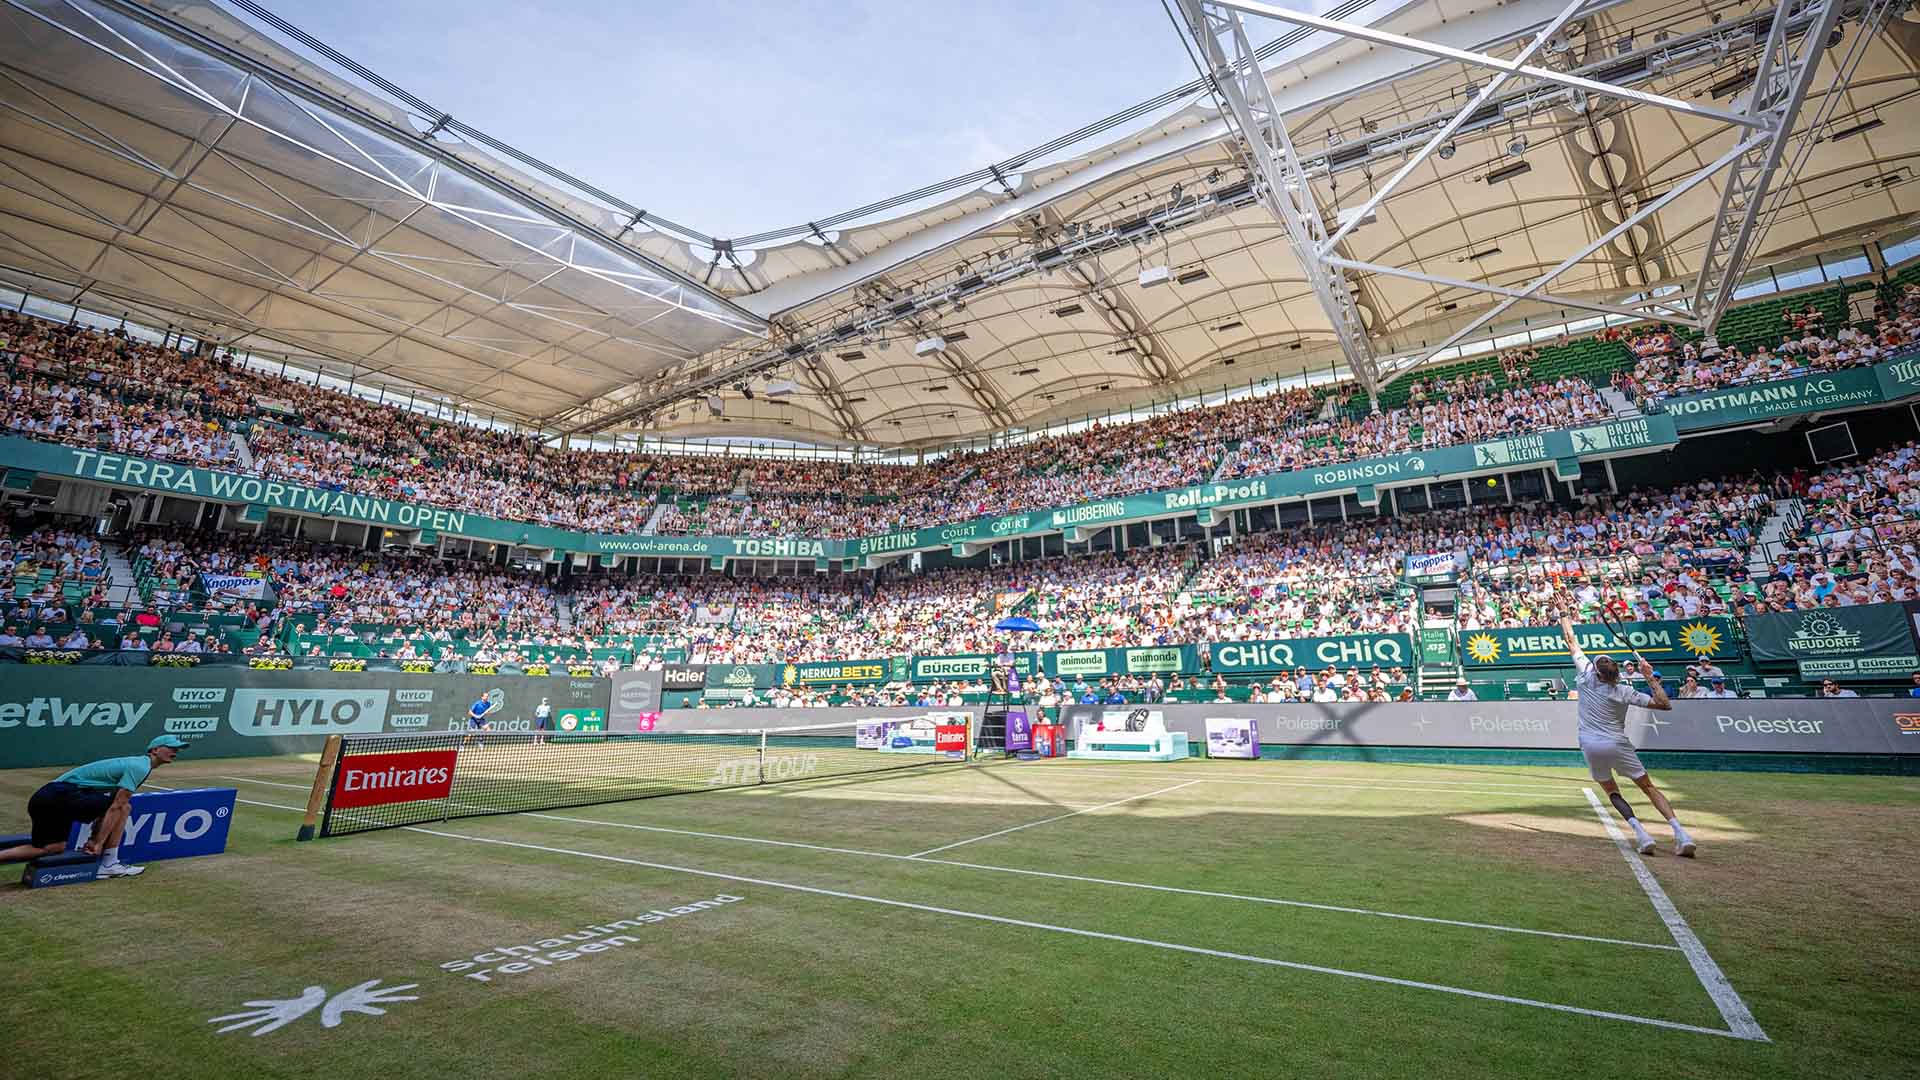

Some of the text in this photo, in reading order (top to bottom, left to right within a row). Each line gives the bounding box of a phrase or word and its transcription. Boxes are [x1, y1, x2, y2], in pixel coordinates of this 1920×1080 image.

[1664, 379, 1836, 416] WORTMANN AG
[1765, 400, 1798, 412] MADE
[1801, 399, 1812, 407] IN
[1608, 419, 1648, 435] BRUNO
[1507, 436, 1544, 451] BRUNO
[1610, 430, 1651, 448] KLEINE
[1509, 446, 1547, 462] KLEINE
[1314, 462, 1400, 485] ROBINSON
[72, 450, 465, 532] TERRA WORTMANN OPEN
[942, 526, 976, 539] COURT
[992, 518, 1029, 532] COURT
[599, 540, 708, 553] www.owl-arena.de
[733, 539, 825, 556] TOSHIBA
[869, 532, 917, 552] VELTINS
[1411, 552, 1455, 570] Knoppers
[204, 576, 260, 589] Knoppers
[1317, 639, 1403, 663] CHiQ
[1789, 637, 1861, 650] NEUDORFF
[1060, 654, 1102, 666] animonda
[1131, 651, 1177, 663] animonda
[1218, 643, 1295, 667] CHiQ
[1862, 658, 1913, 668] BÜRGER
[800, 667, 840, 679] MERKUR
[842, 665, 883, 677] BETS
[923, 662, 980, 674] BÜRGER
[1804, 661, 1850, 670] BÜRGER
[664, 669, 705, 682] Haier
[0, 697, 153, 734] etway
[448, 716, 530, 731] bitanda
[1276, 715, 1342, 731] Polestar
[1469, 715, 1552, 732] Polestar
[1715, 715, 1823, 734] Polestar
[344, 766, 448, 791] Emirates
[440, 893, 744, 973] schauinsland
[465, 934, 641, 982] reisen
